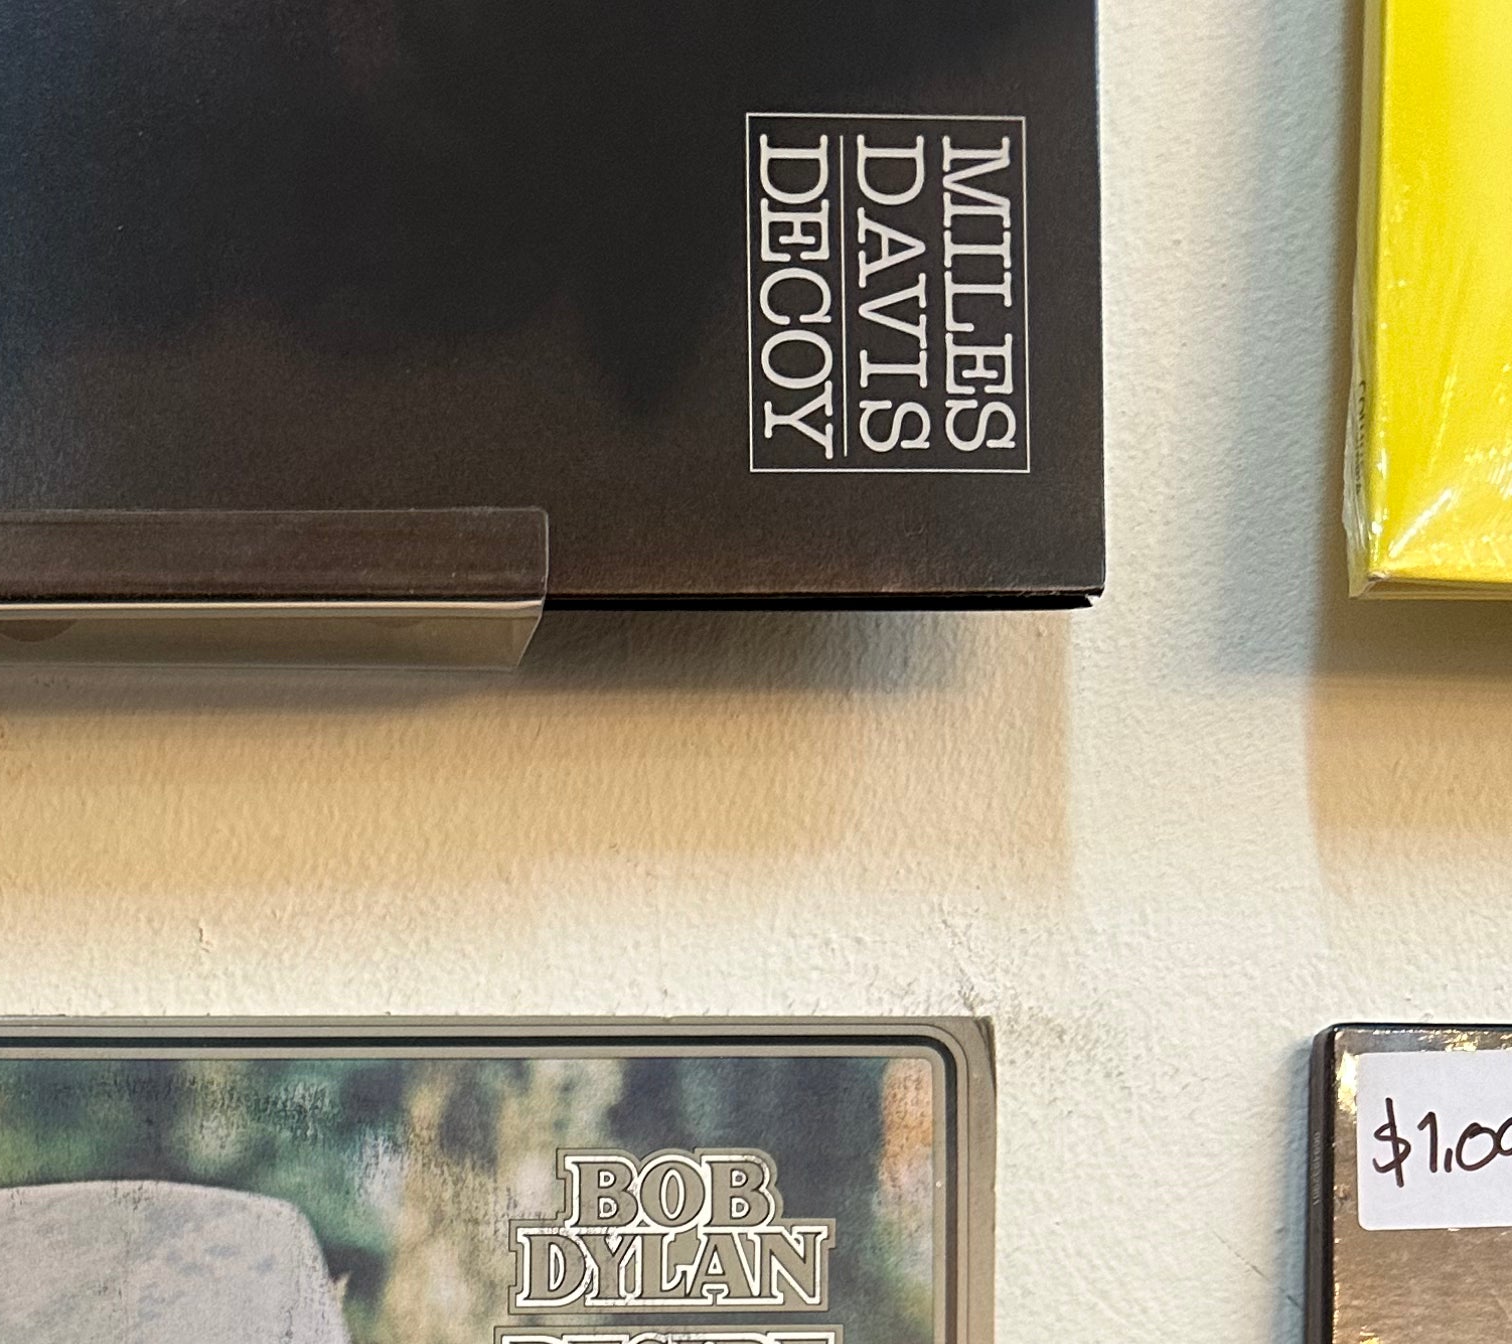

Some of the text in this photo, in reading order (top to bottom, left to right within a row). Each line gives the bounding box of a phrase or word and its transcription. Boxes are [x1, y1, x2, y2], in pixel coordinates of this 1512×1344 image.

[758, 133, 834, 460] DECOY
[856, 134, 931, 454] DAVIS
[942, 135, 1017, 453] MILES
[515, 1224, 830, 1307] DYLAN
[563, 1153, 778, 1230] BOB
